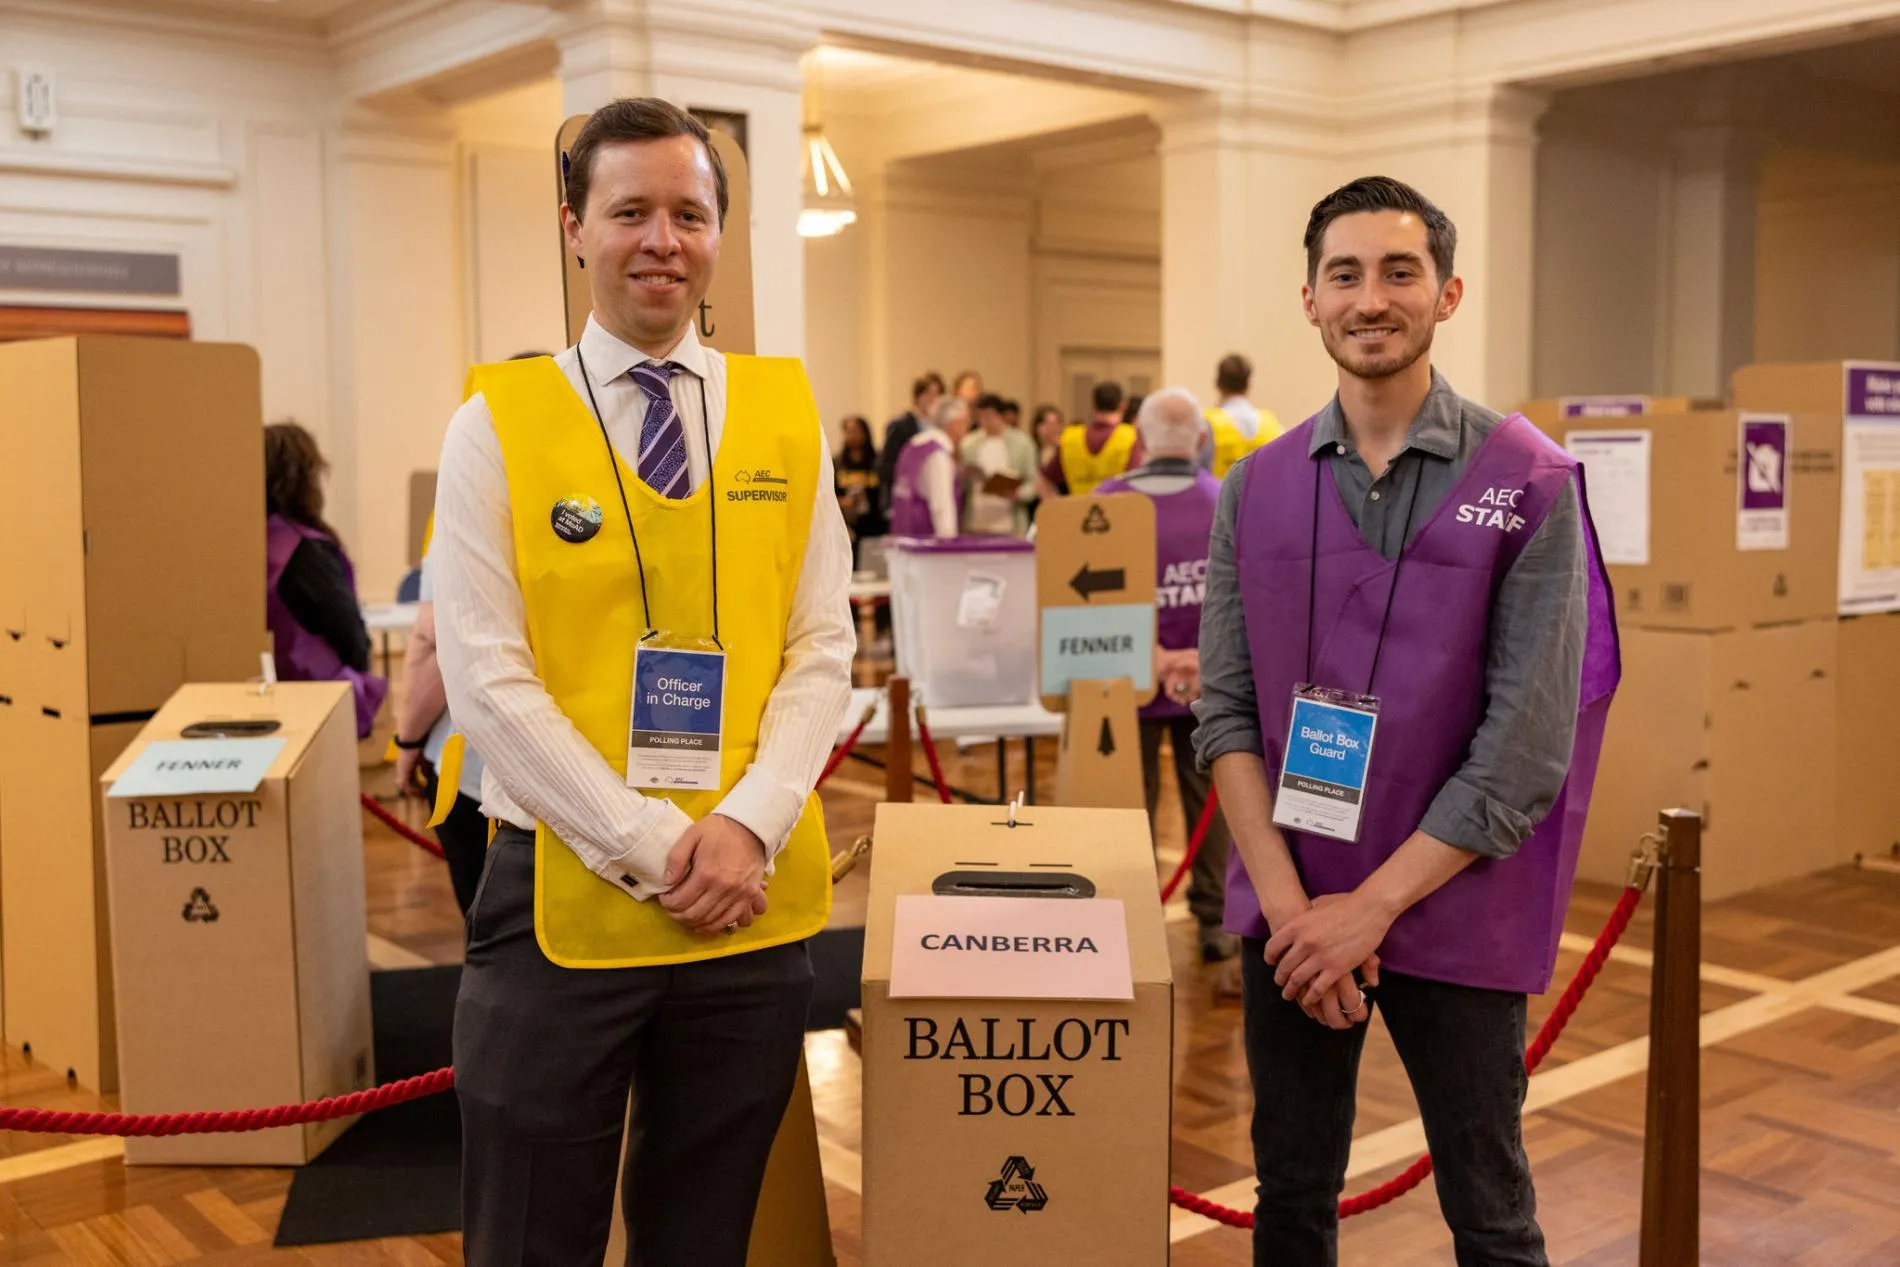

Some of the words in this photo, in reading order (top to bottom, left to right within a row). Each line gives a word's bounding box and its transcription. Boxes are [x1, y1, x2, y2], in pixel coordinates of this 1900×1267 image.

[754, 469, 771, 478] AEC
[727, 489, 787, 503] SUPERVISOR
[1478, 487, 1525, 508] AEC
[565, 513, 582, 524] voted
[1455, 503, 1526, 533] STAF
[1059, 633, 1134, 656] FENNER
[657, 677, 703, 692] Officer
[646, 692, 658, 705] in
[662, 693, 711, 710] Charge
[649, 736, 679, 745] POLLING
[680, 738, 703, 746] PLACE
[1301, 726, 1334, 744] Ballot
[1336, 734, 1360, 750] Box
[1310, 743, 1345, 760] Guard
[157, 759, 241, 770] FENNER
[1298, 781, 1323, 791] POLLING
[1324, 787, 1344, 796] PLACE
[129, 801, 261, 829] BALLOT
[163, 837, 230, 863] BOX
[920, 934, 1099, 953] CANBERRA
[904, 1017, 1129, 1061] BALLOT
[958, 1073, 1075, 1116] BOX
